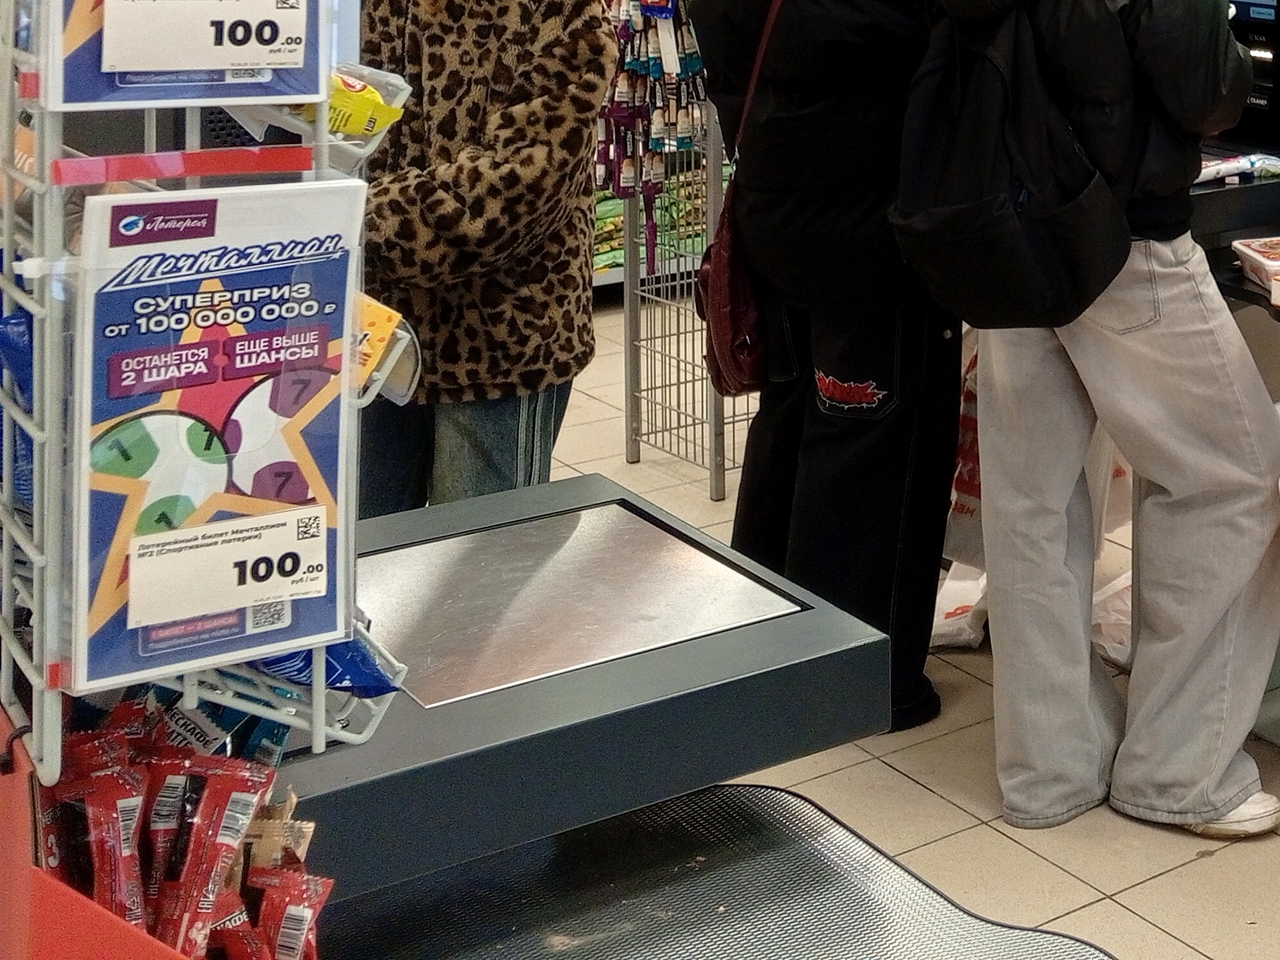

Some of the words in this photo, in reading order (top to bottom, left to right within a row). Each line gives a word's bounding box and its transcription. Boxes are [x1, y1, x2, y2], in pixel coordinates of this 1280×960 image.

[146, 215, 208, 232] Лотерея
[102, 236, 343, 292] Мечталлион
[133, 283, 312, 314] СУПЕРПРИЗ
[136, 310, 190, 333] 100
[195, 306, 256, 329] 000
[261, 300, 319, 323] 000
[235, 338, 269, 353] ЕЩЕ
[272, 331, 319, 349] ВЫШЕ
[121, 347, 209, 371] ОСТАНЕТСЯ
[235, 345, 319, 369] ШАНСЫ
[120, 372, 136, 386] 2
[143, 362, 208, 383] ШАРА
[291, 379, 311, 405] 7
[108, 438, 132, 462] 1
[273, 472, 293, 498] 7
[137, 534, 199, 552] Лотерейный
[201, 529, 230, 542] билет
[231, 521, 288, 537] Мечталлион
[156, 541, 219, 558] (Спортивные
[221, 532, 262, 546] лотереи)
